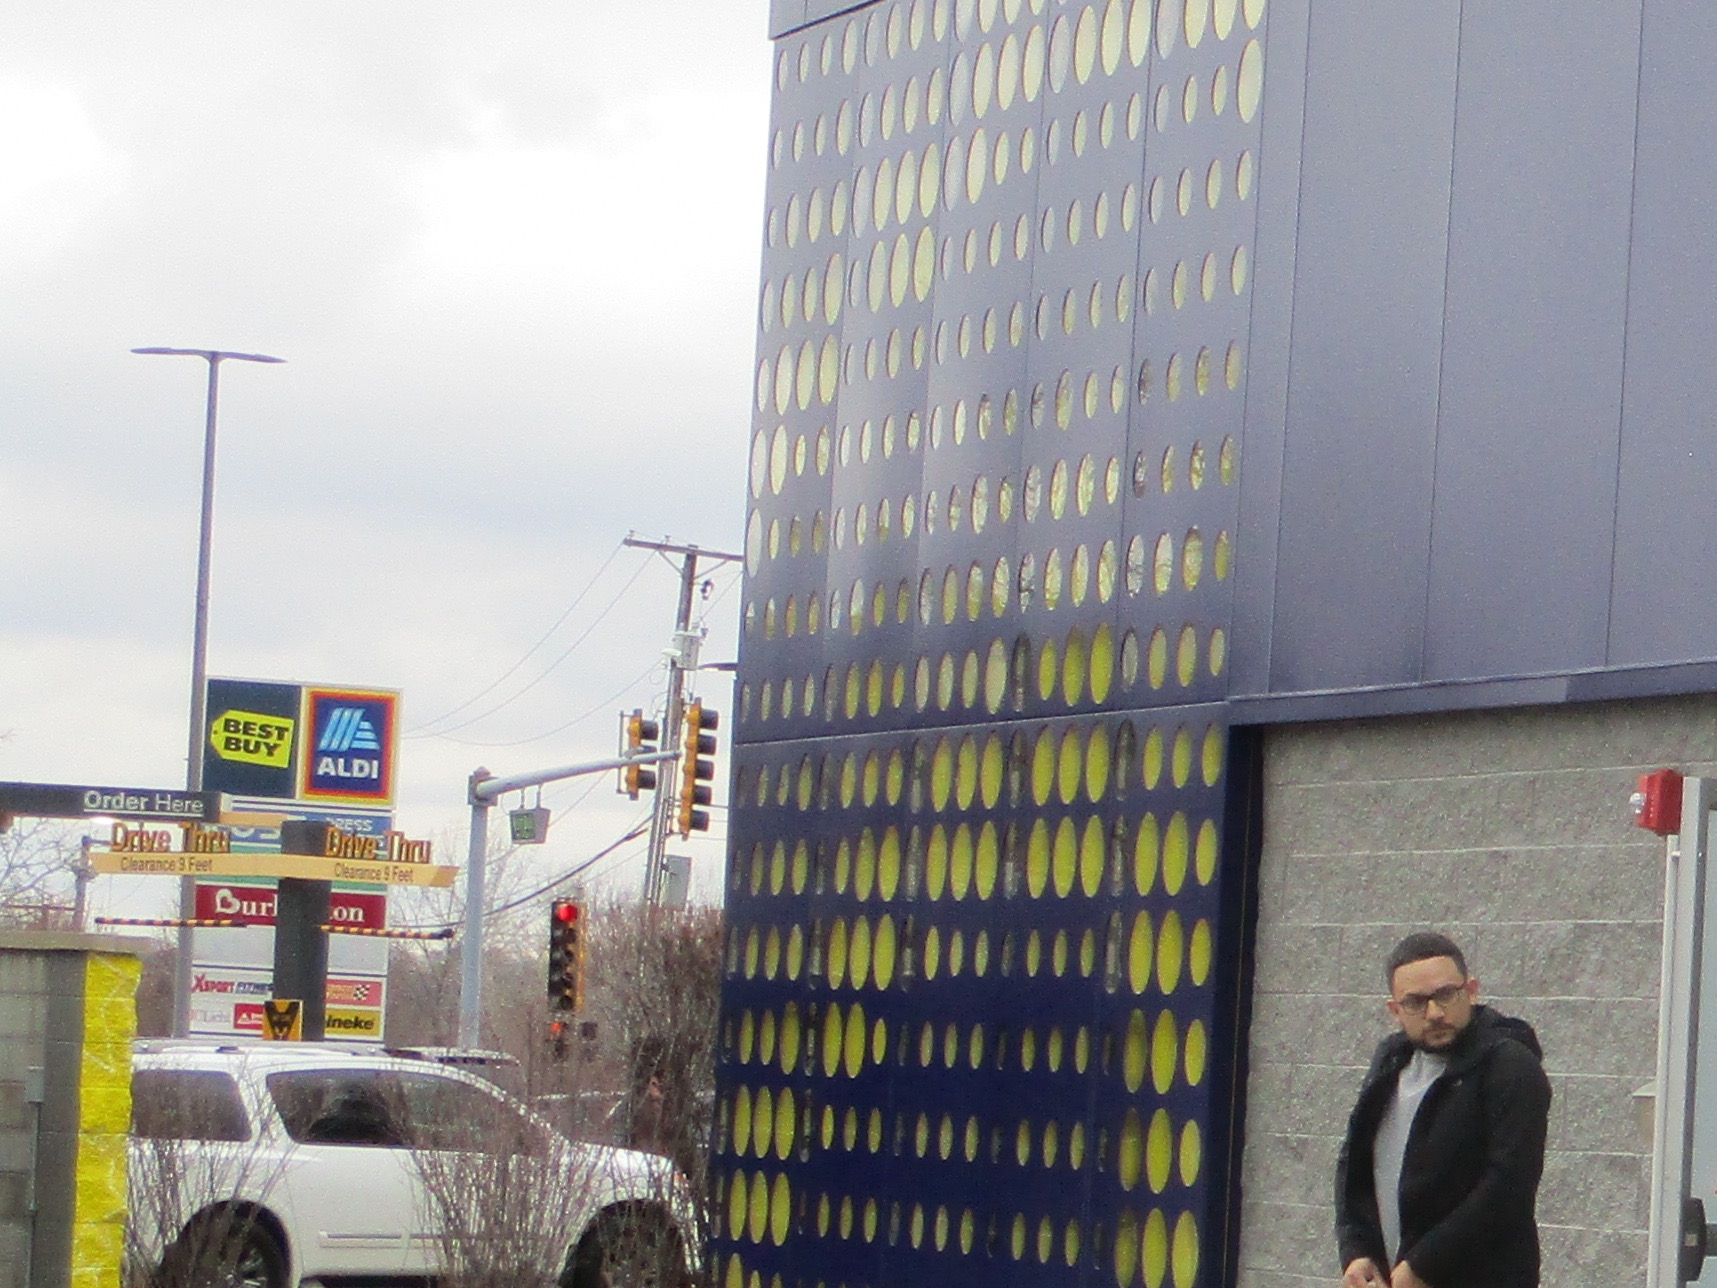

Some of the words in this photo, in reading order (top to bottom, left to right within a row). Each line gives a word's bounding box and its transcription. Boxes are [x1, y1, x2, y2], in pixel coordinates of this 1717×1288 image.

[223, 718, 289, 741] BEST
[224, 737, 282, 757] BUY
[317, 756, 379, 779] ALDI
[84, 790, 149, 811] Order
[155, 793, 204, 813] Here
[111, 822, 171, 852] Drive
[178, 821, 231, 853] Thru
[324, 825, 378, 859] Drive
[383, 830, 432, 864] Thru
[120, 857, 176, 872] Clearance
[179, 857, 186, 872] 9
[190, 857, 213, 872] Feet
[334, 863, 382, 880] Clearance
[384, 865, 391, 881] 9
[392, 866, 414, 883] Feet
[326, 1014, 374, 1030] ineke
